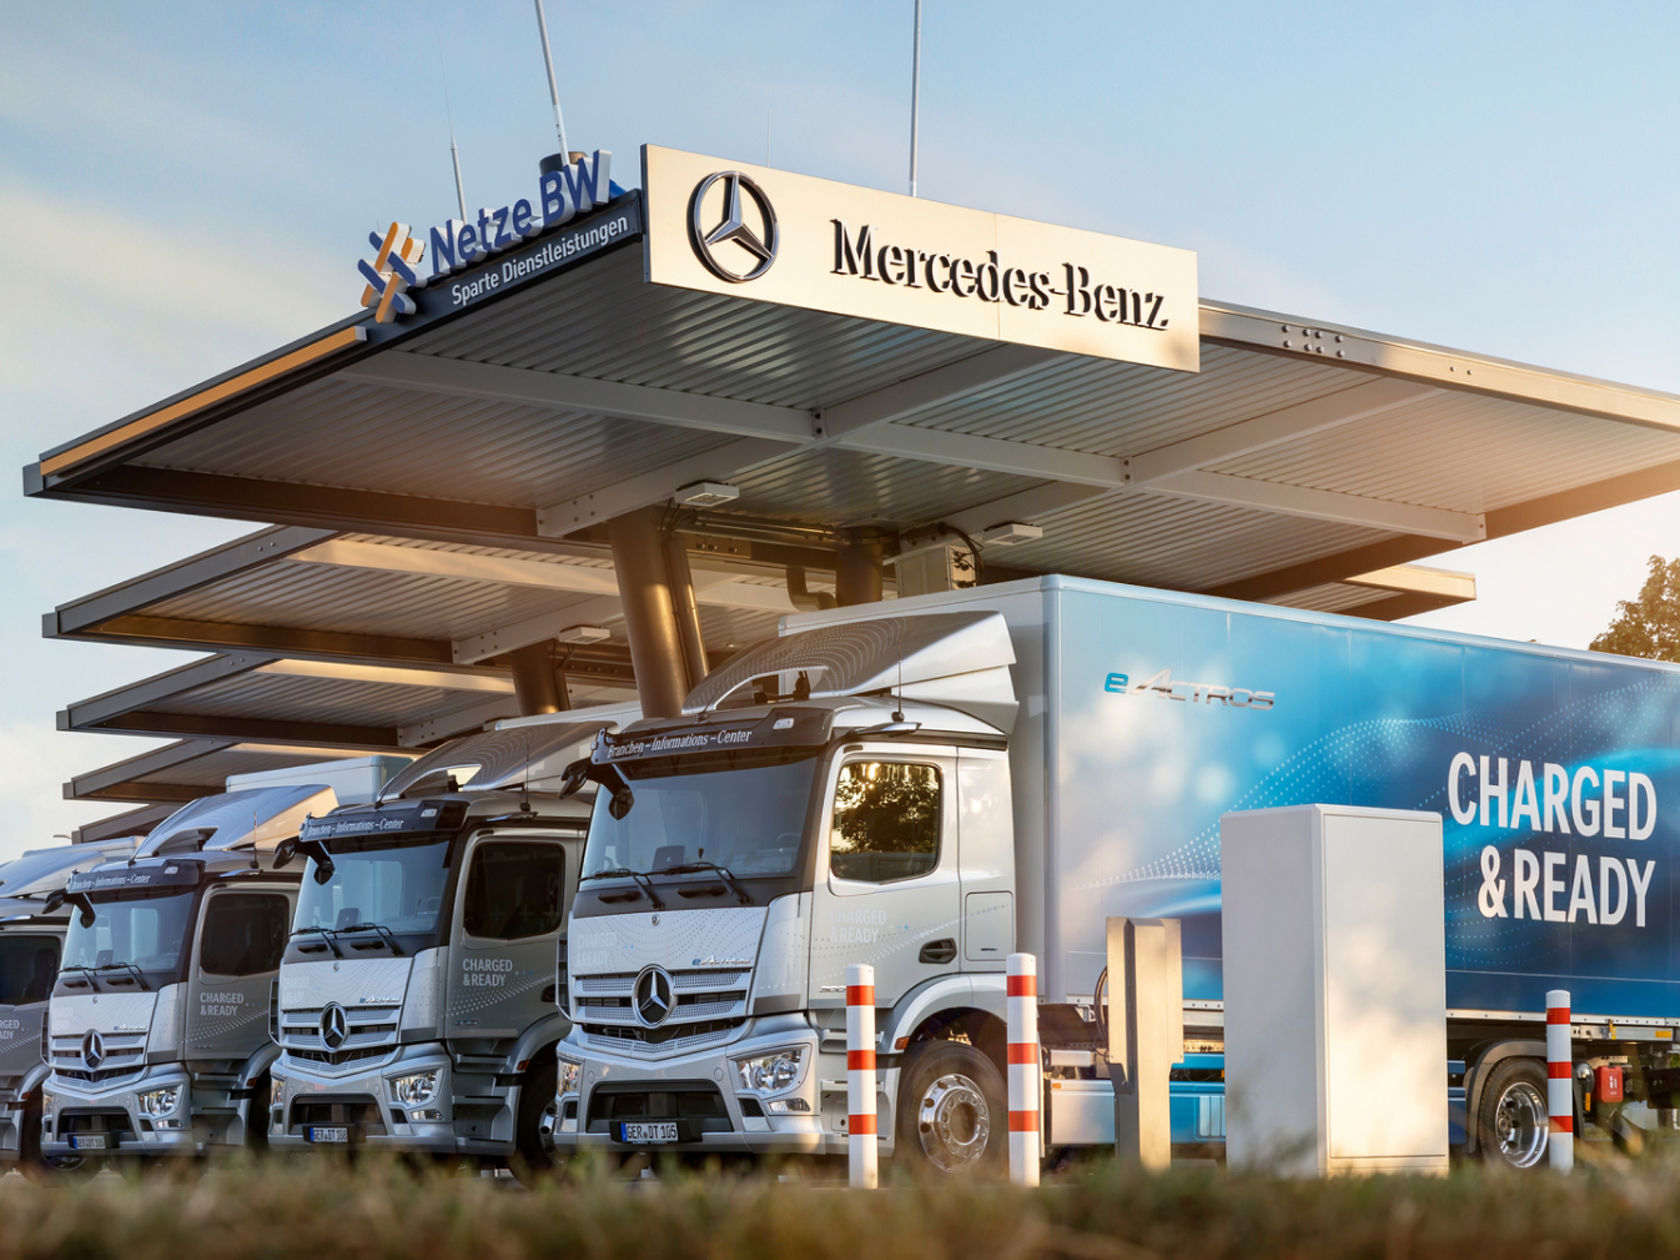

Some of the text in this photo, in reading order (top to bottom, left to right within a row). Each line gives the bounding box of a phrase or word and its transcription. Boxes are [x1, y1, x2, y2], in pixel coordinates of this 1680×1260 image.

[430, 149, 603, 275] Netze BW
[452, 216, 628, 306] Sparte Dienstleistungen
[830, 218, 1169, 331] Mercedes-Benz
[651, 733, 709, 751] Informations
[717, 729, 753, 744] Center
[1448, 752, 1657, 841] CHARGED
[463, 958, 513, 973] CHARGED
[200, 992, 244, 1004] CHARGED
[626, 1125, 643, 1139] GER
[648, 1125, 659, 1139] DT
